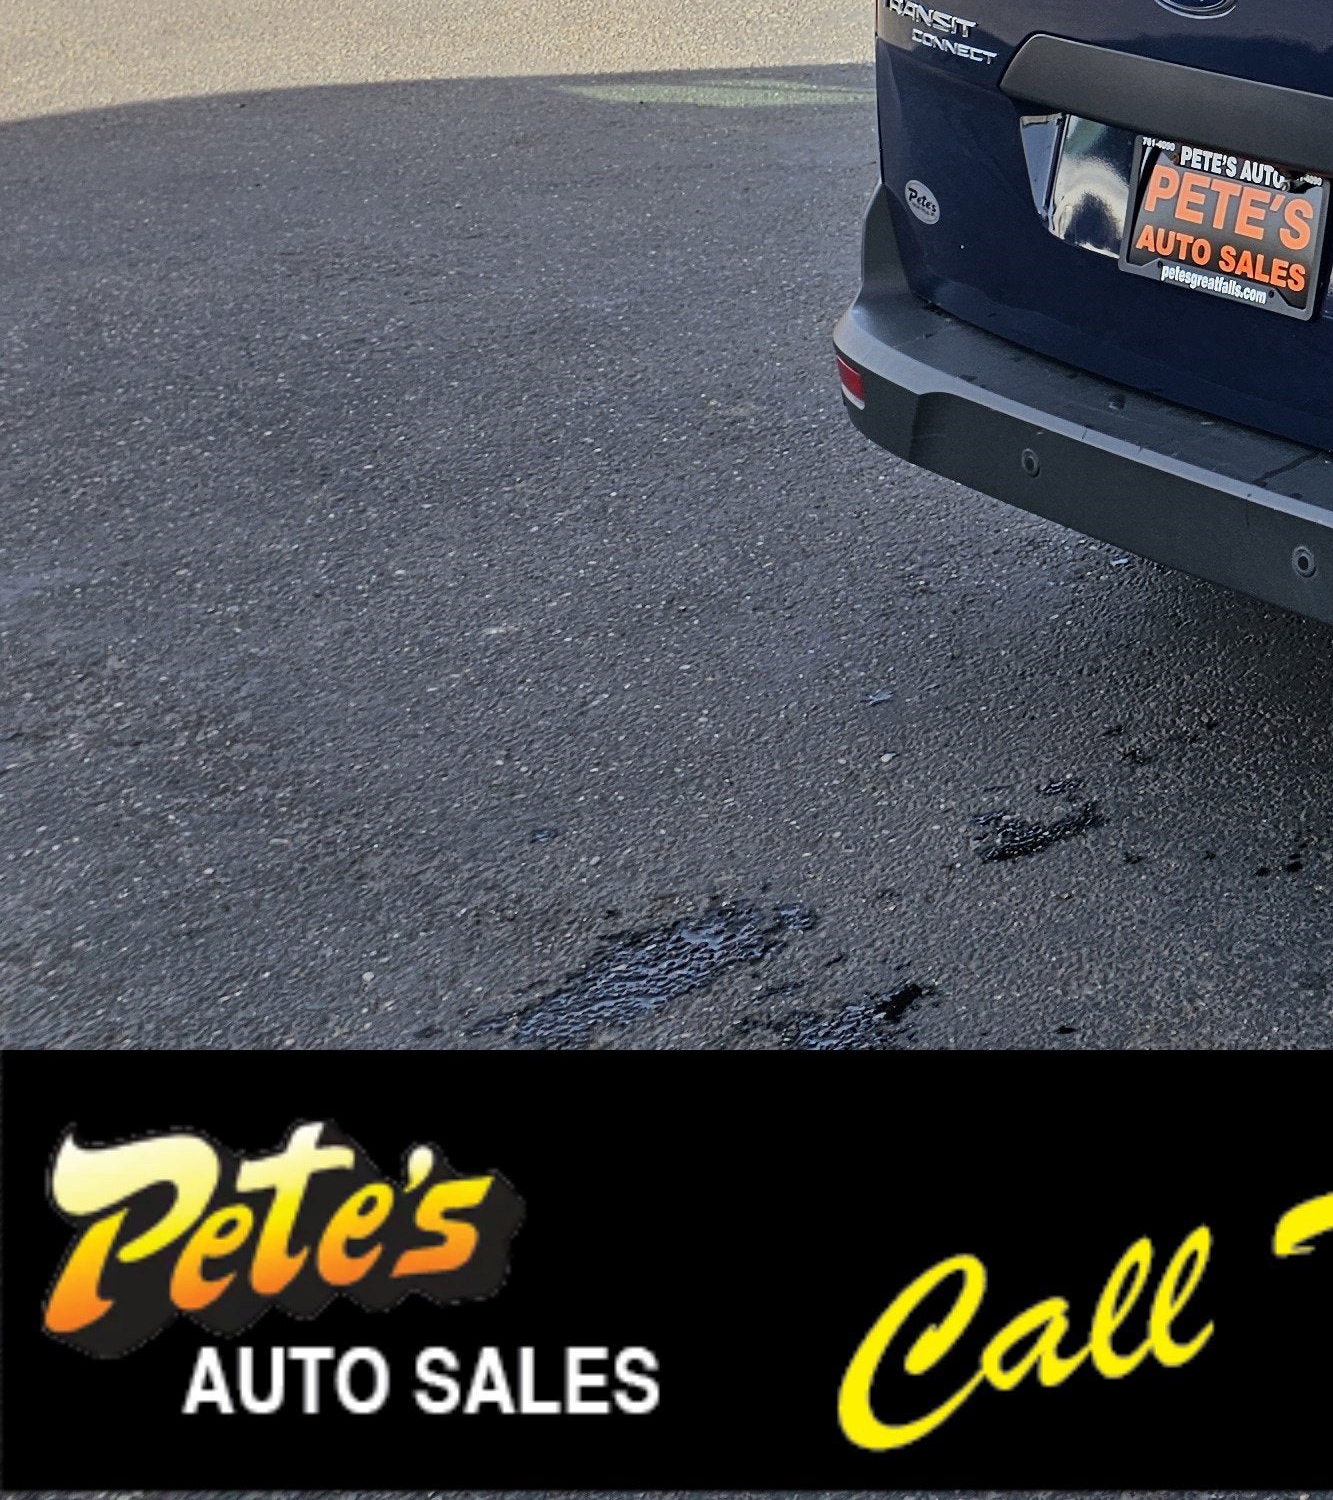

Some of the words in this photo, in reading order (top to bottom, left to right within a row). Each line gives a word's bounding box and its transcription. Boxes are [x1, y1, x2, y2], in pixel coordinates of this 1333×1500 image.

[911, 28, 998, 65] CONNECT
[1180, 146, 1238, 179] PETE'S
[1239, 160, 1286, 190] AUTO
[1143, 163, 1314, 250] PETE'S
[1135, 224, 1212, 266] AUTO
[1218, 245, 1306, 292] SALES
[1160, 264, 1267, 304] petesgreatfalls.com
